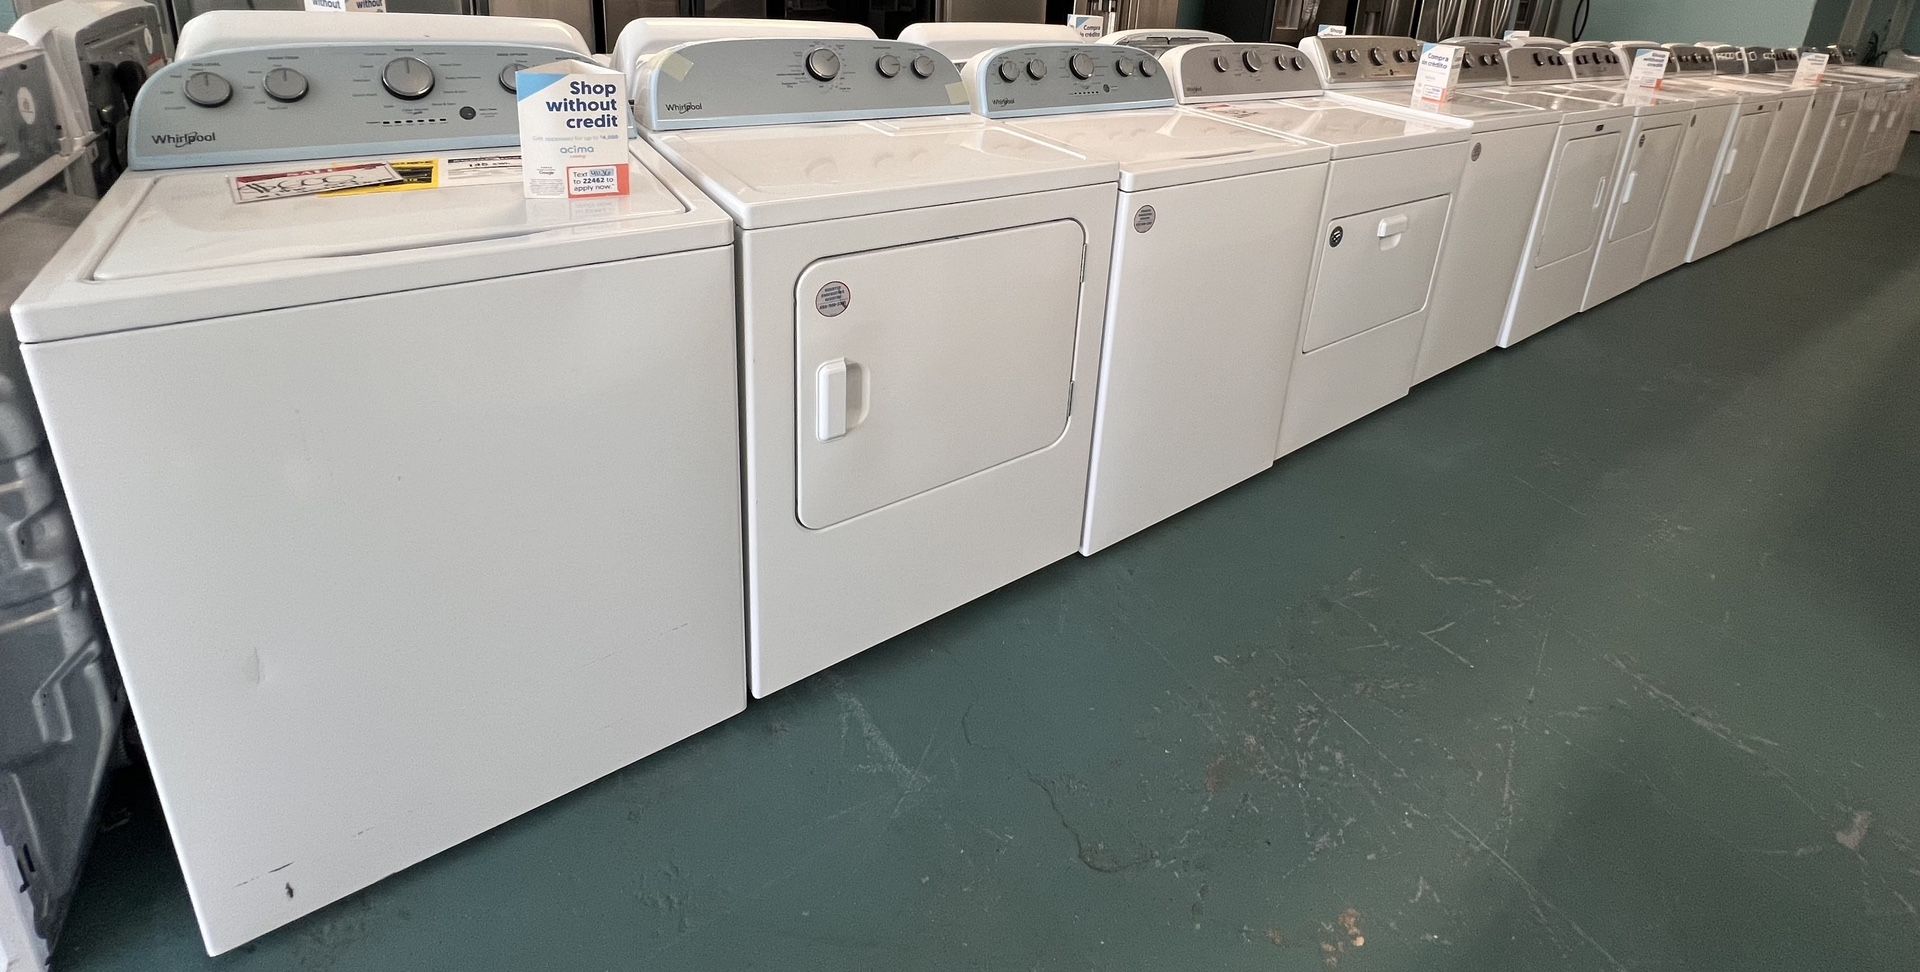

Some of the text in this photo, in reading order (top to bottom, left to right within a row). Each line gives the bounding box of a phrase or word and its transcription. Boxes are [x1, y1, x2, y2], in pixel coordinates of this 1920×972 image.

[1428, 53, 1449, 62] Compra
[569, 81, 617, 97] Shop
[546, 98, 618, 112] without
[665, 101, 703, 114] Whirlpool
[566, 114, 618, 129] credit
[151, 131, 216, 147] Whirlpool
[559, 145, 595, 154] acima
